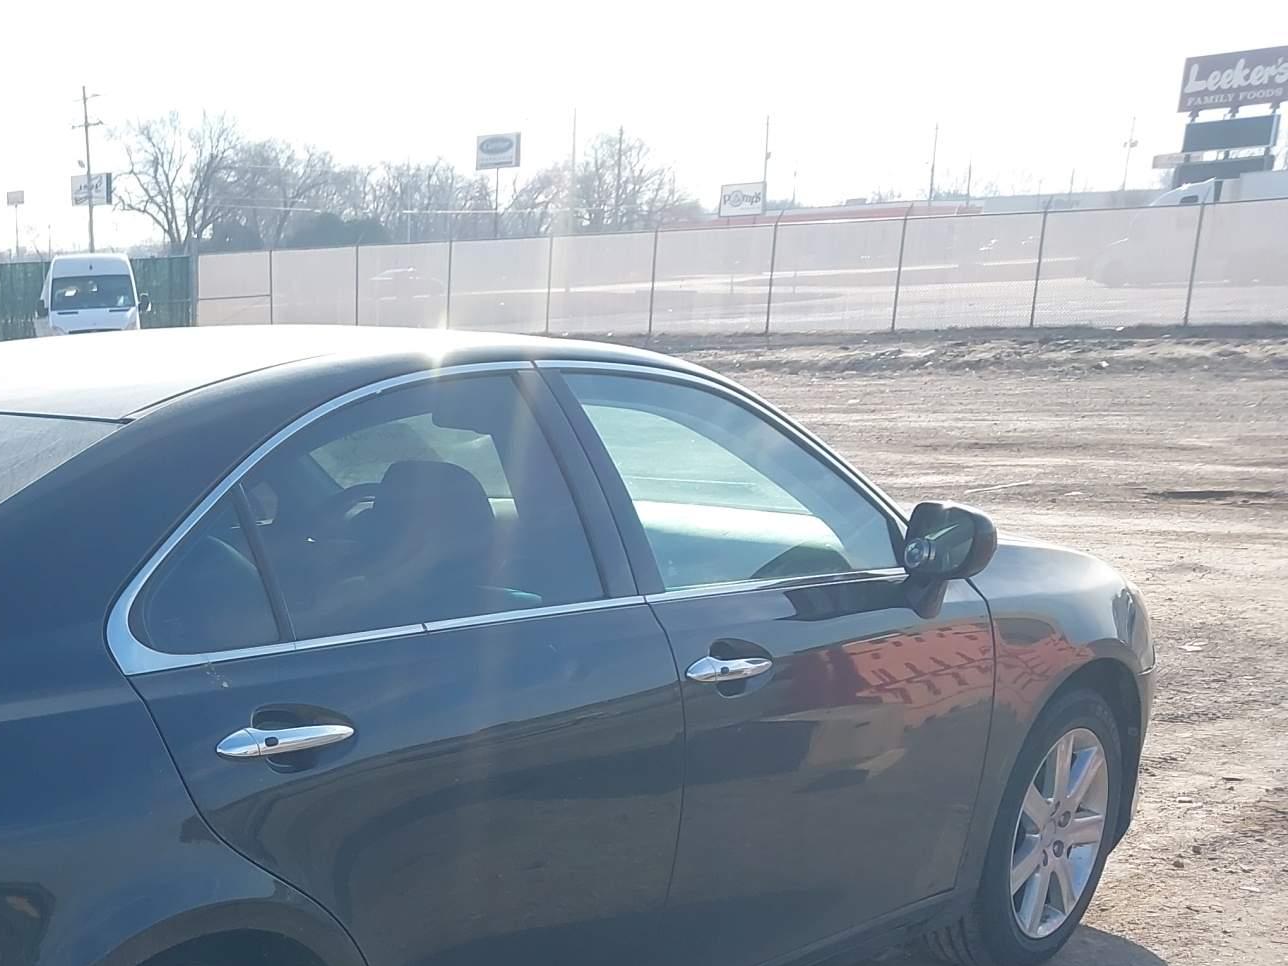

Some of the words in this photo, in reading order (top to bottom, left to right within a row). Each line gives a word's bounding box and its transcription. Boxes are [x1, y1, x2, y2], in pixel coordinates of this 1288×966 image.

[1184, 56, 1288, 93] Leeker's
[1186, 93, 1235, 106] FAMILY
[1239, 87, 1284, 101] FOODS
